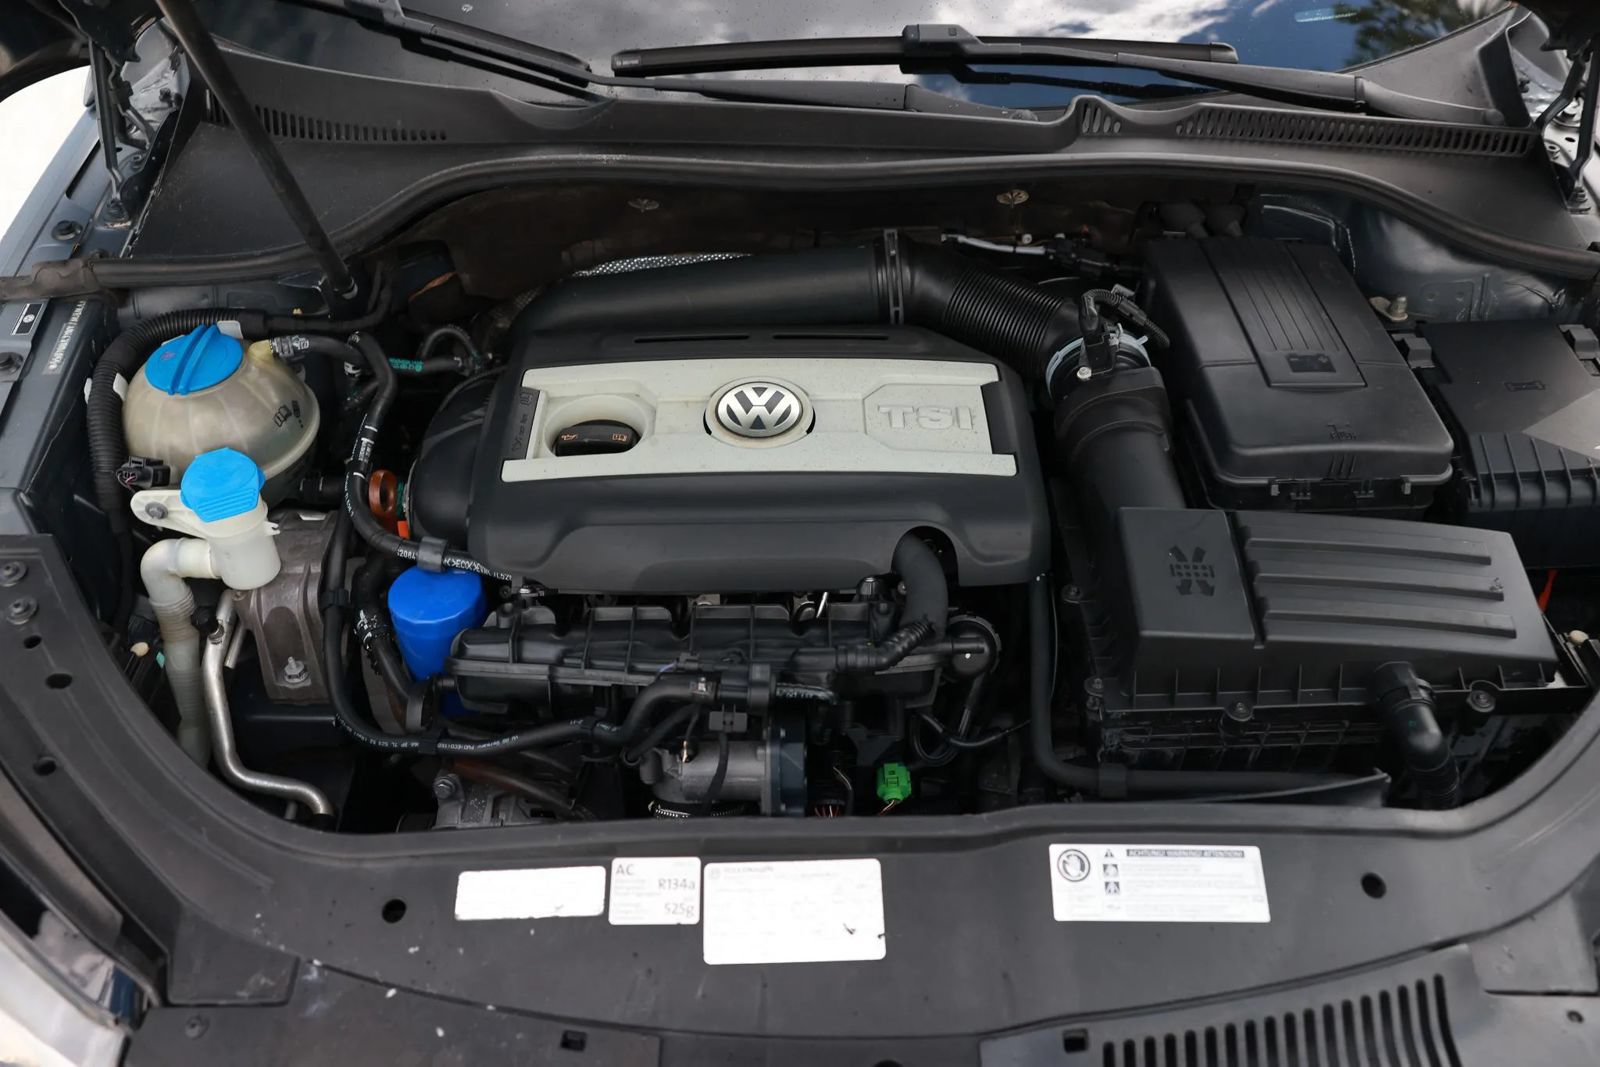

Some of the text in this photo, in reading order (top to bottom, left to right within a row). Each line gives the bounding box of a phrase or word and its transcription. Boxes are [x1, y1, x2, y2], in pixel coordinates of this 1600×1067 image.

[716, 381, 803, 438] VW
[878, 405, 975, 431] TSI
[616, 864, 634, 876] AC
[658, 878, 696, 890] R134a
[664, 902, 695, 918] 525g
